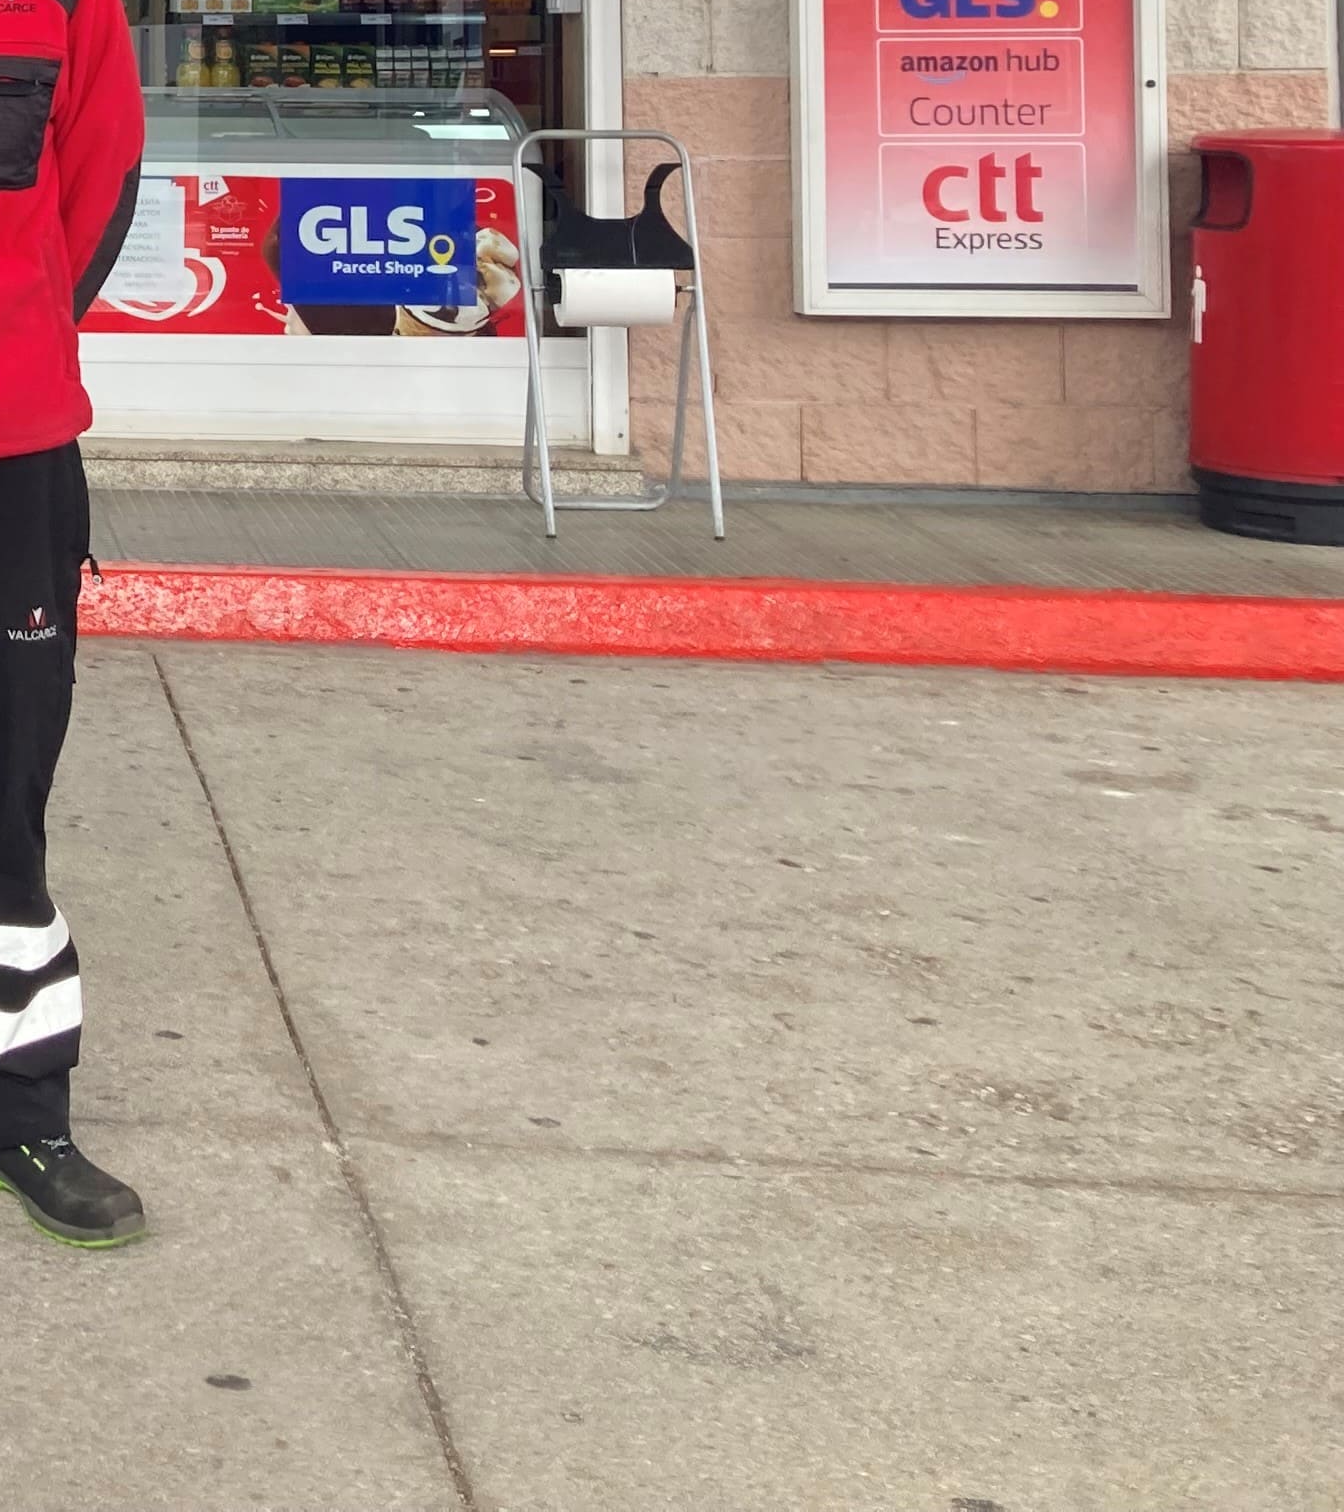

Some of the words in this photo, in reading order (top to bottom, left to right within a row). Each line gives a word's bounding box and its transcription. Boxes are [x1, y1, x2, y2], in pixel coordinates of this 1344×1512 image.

[900, 50, 999, 74] amazon
[1006, 48, 1060, 74] hub
[909, 96, 1051, 128] Counter
[921, 152, 1044, 223] ctt
[298, 205, 427, 255] GLS
[935, 227, 1043, 255] Express
[333, 260, 380, 274] Parcel
[385, 260, 425, 278] Shop
[7, 624, 57, 642] VALCARCE
